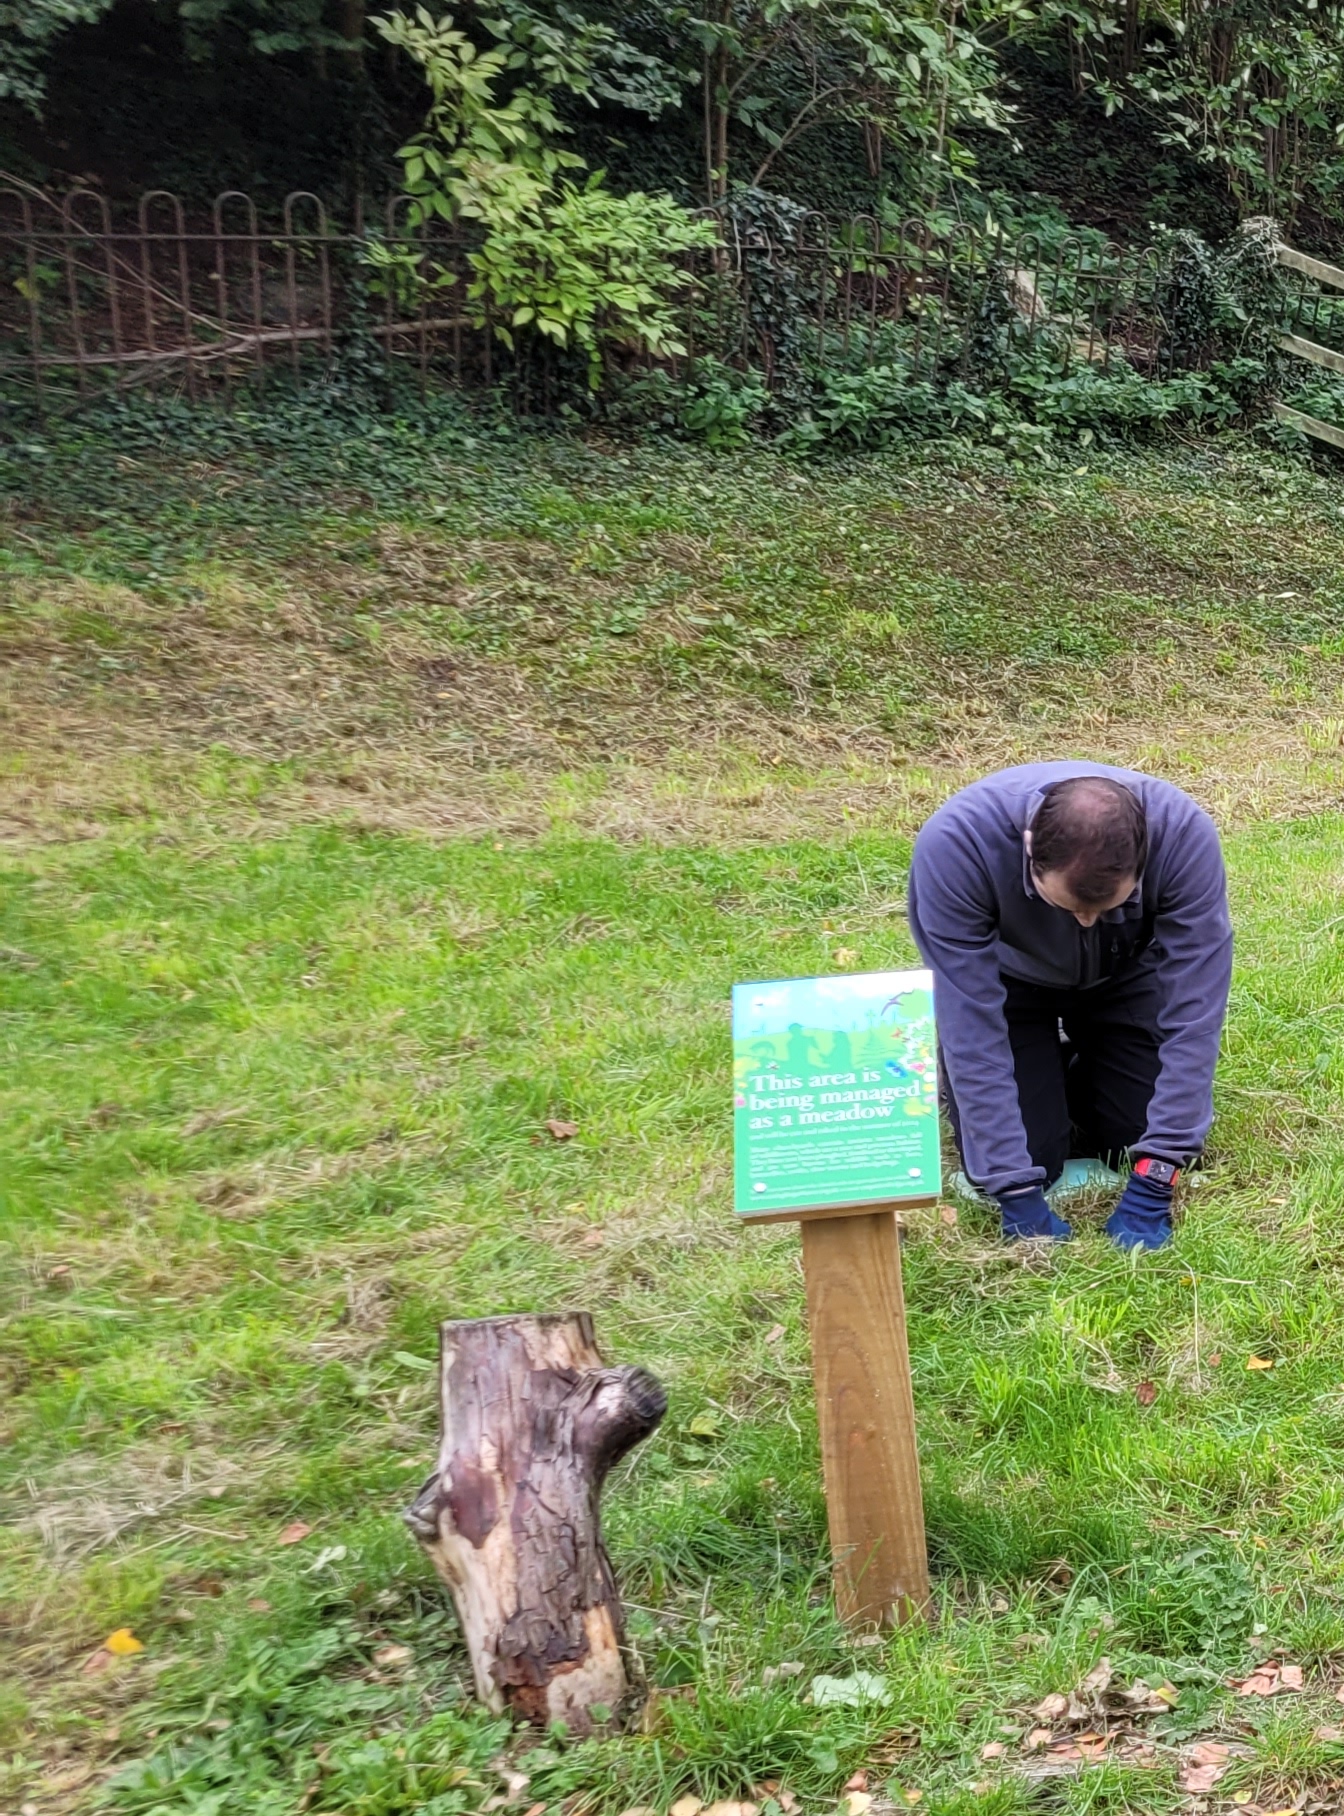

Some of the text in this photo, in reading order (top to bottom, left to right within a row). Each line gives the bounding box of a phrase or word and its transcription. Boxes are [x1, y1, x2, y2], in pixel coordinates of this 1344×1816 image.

[749, 1067, 881, 1092] This area is
[749, 1079, 921, 1112] being managed
[749, 1115, 774, 1130] as
[779, 1114, 793, 1127] a
[798, 1102, 896, 1125] meadow
